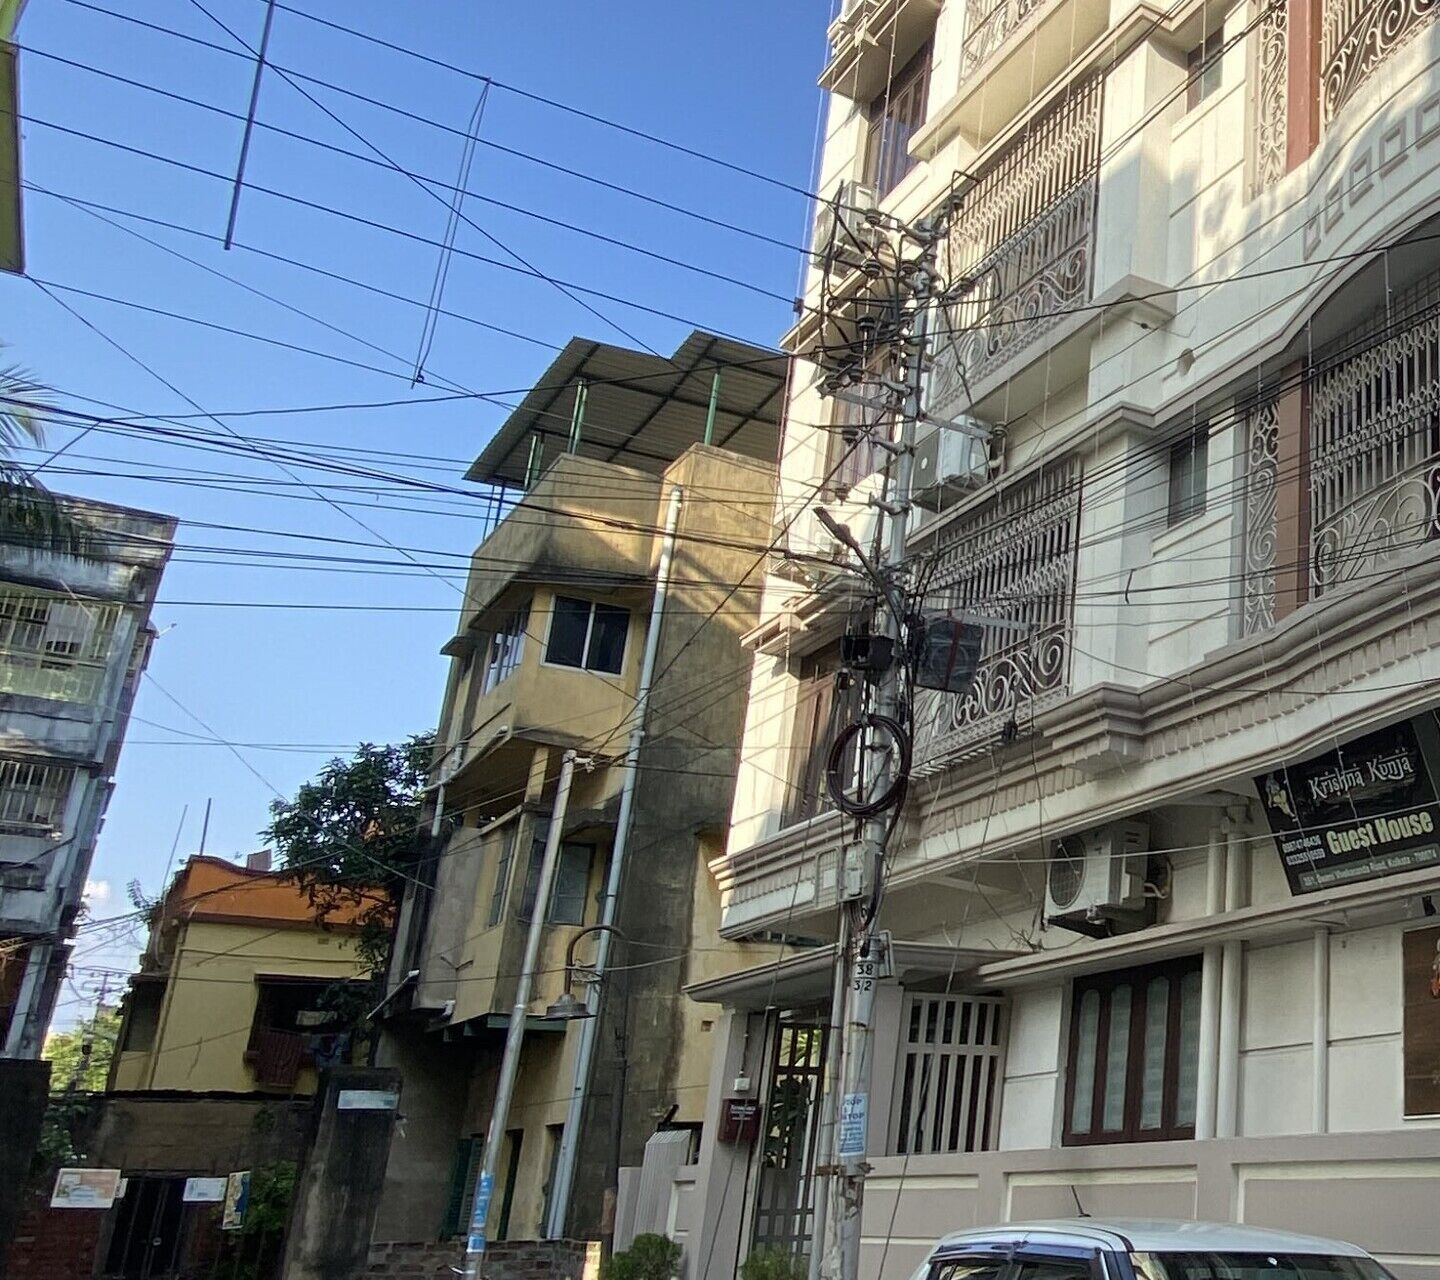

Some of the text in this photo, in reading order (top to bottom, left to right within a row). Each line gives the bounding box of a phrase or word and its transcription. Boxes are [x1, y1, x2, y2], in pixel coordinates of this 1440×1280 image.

[1308, 747, 1414, 799] Krishna Kunja
[1326, 823, 1378, 855] Guest
[1374, 811, 1434, 844] House
[856, 963, 873, 975] 38
